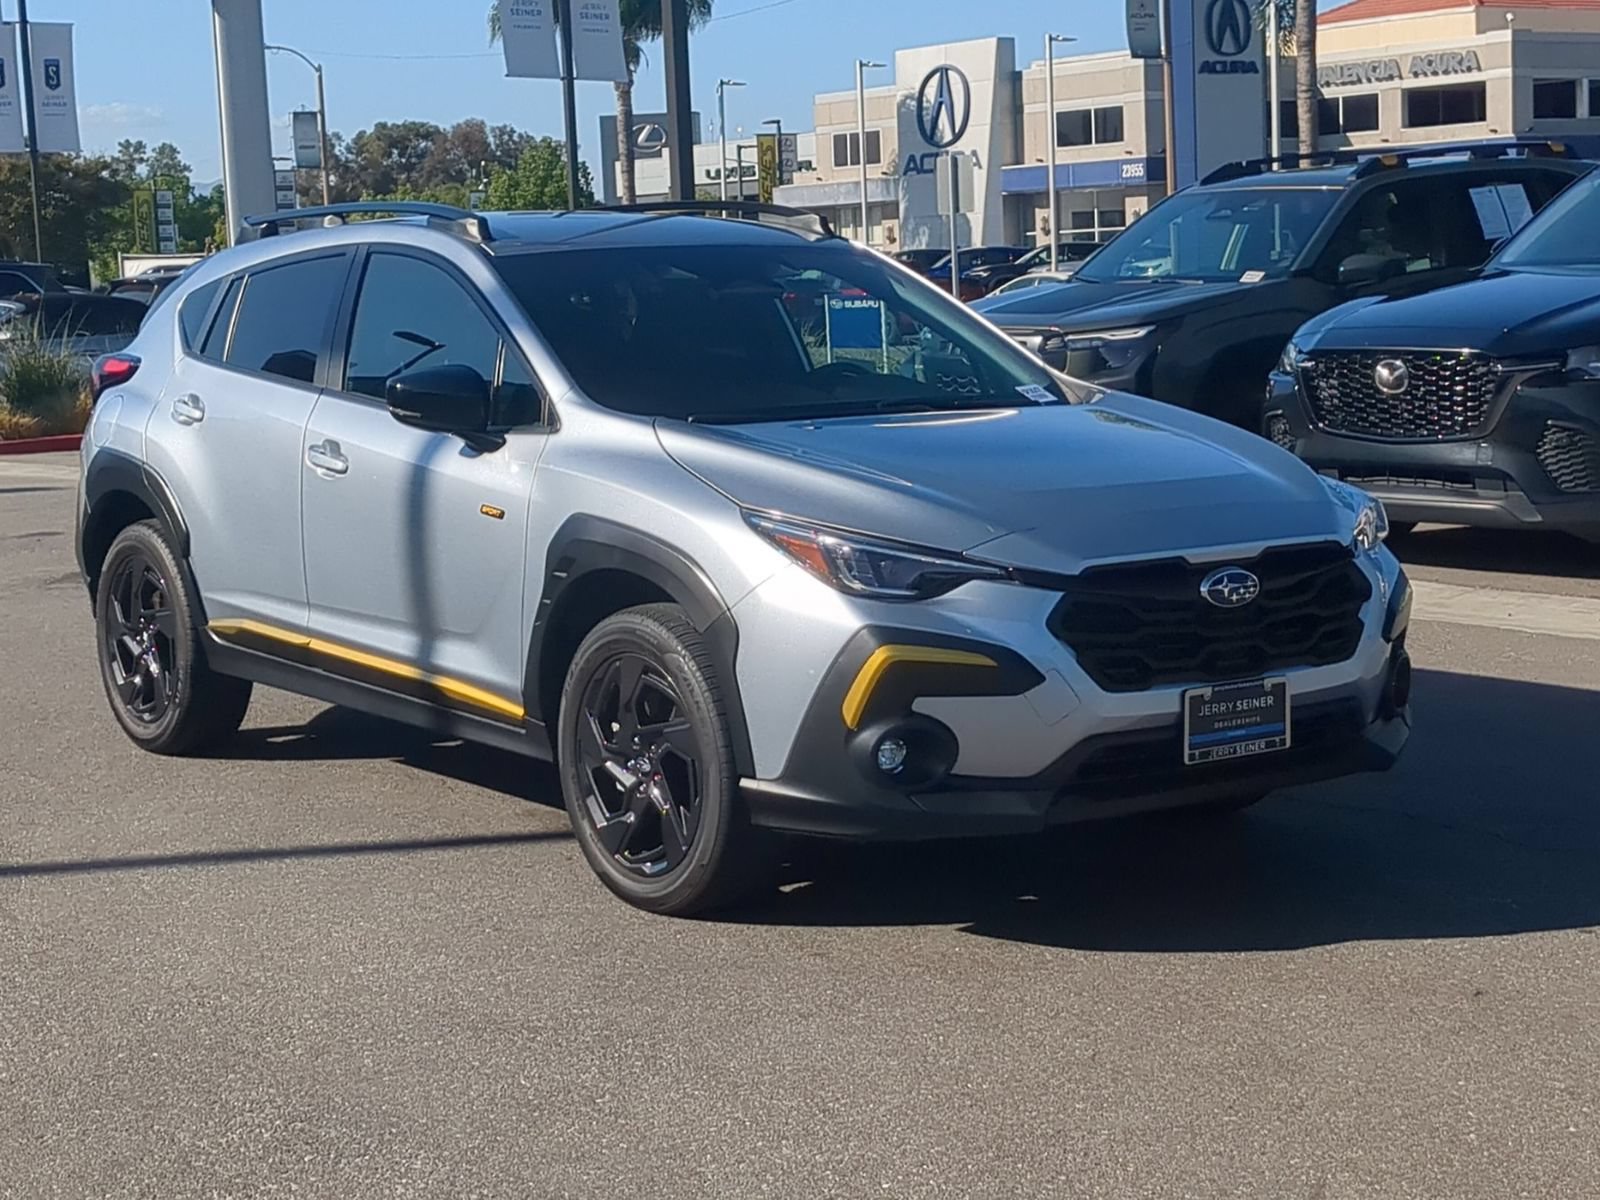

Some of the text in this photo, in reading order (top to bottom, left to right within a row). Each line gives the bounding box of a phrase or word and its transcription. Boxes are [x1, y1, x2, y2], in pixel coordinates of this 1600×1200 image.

[510, 8, 542, 17] SEINER
[579, 12, 609, 20] SEINER
[1198, 60, 1259, 74] ACURA
[1408, 51, 1481, 76] ACURA
[903, 150, 982, 176] ACA
[1122, 163, 1144, 178] 23955
[844, 300, 879, 308] SUBARU
[1199, 695, 1274, 717] JERRY SEINER
[1208, 742, 1266, 760] JERRY SEINER
